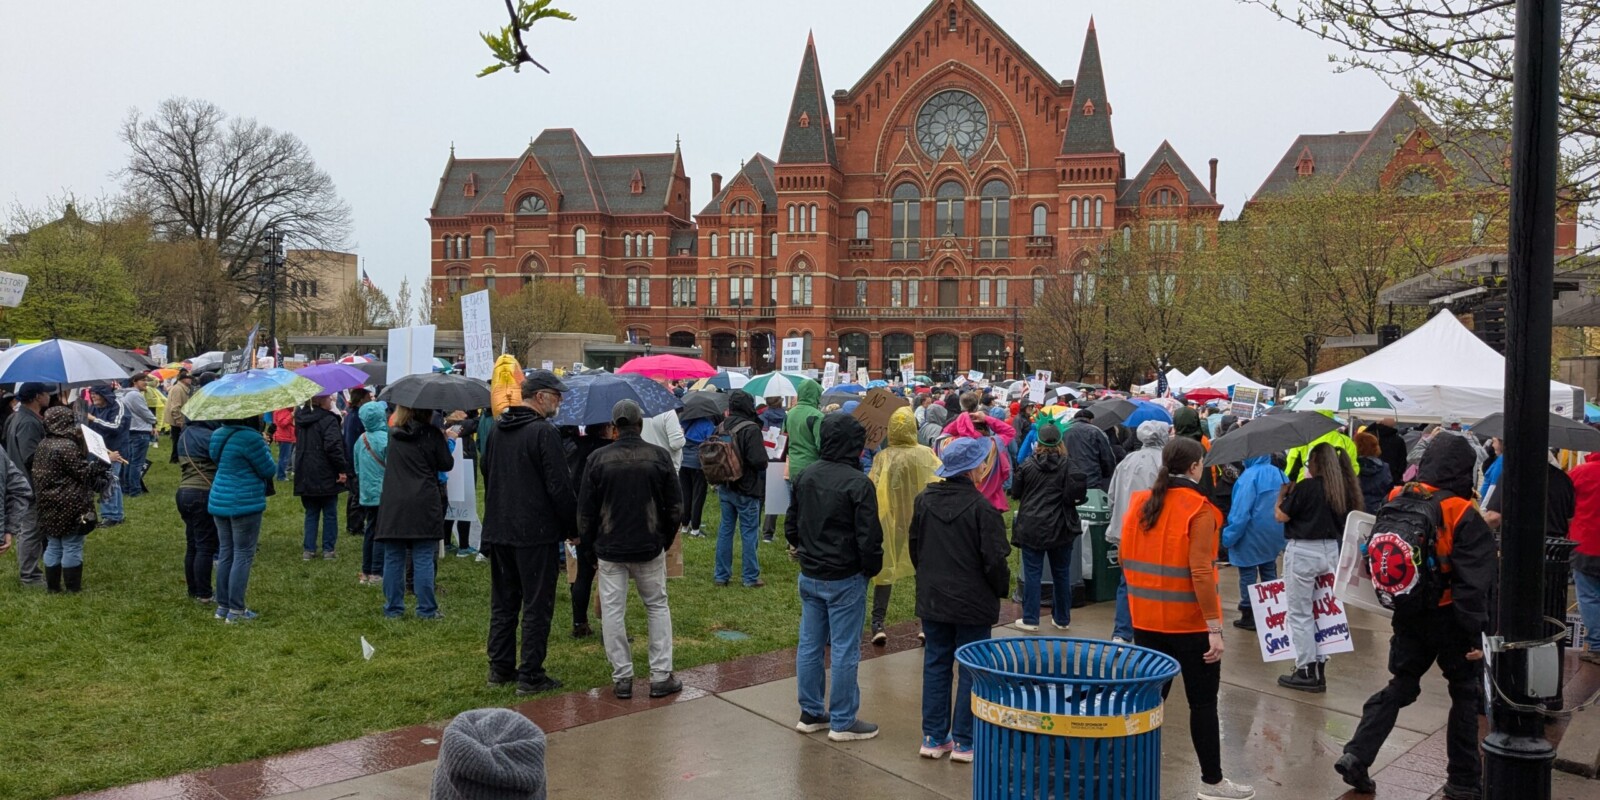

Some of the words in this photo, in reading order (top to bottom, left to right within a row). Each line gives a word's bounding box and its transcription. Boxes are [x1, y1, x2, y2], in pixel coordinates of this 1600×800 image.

[0, 276, 24, 287] ISTORY
[867, 393, 887, 409] NO
[1394, 537, 1411, 558] MEDIC
[1391, 584, 1405, 593] AID
[1264, 632, 1291, 654] Save
